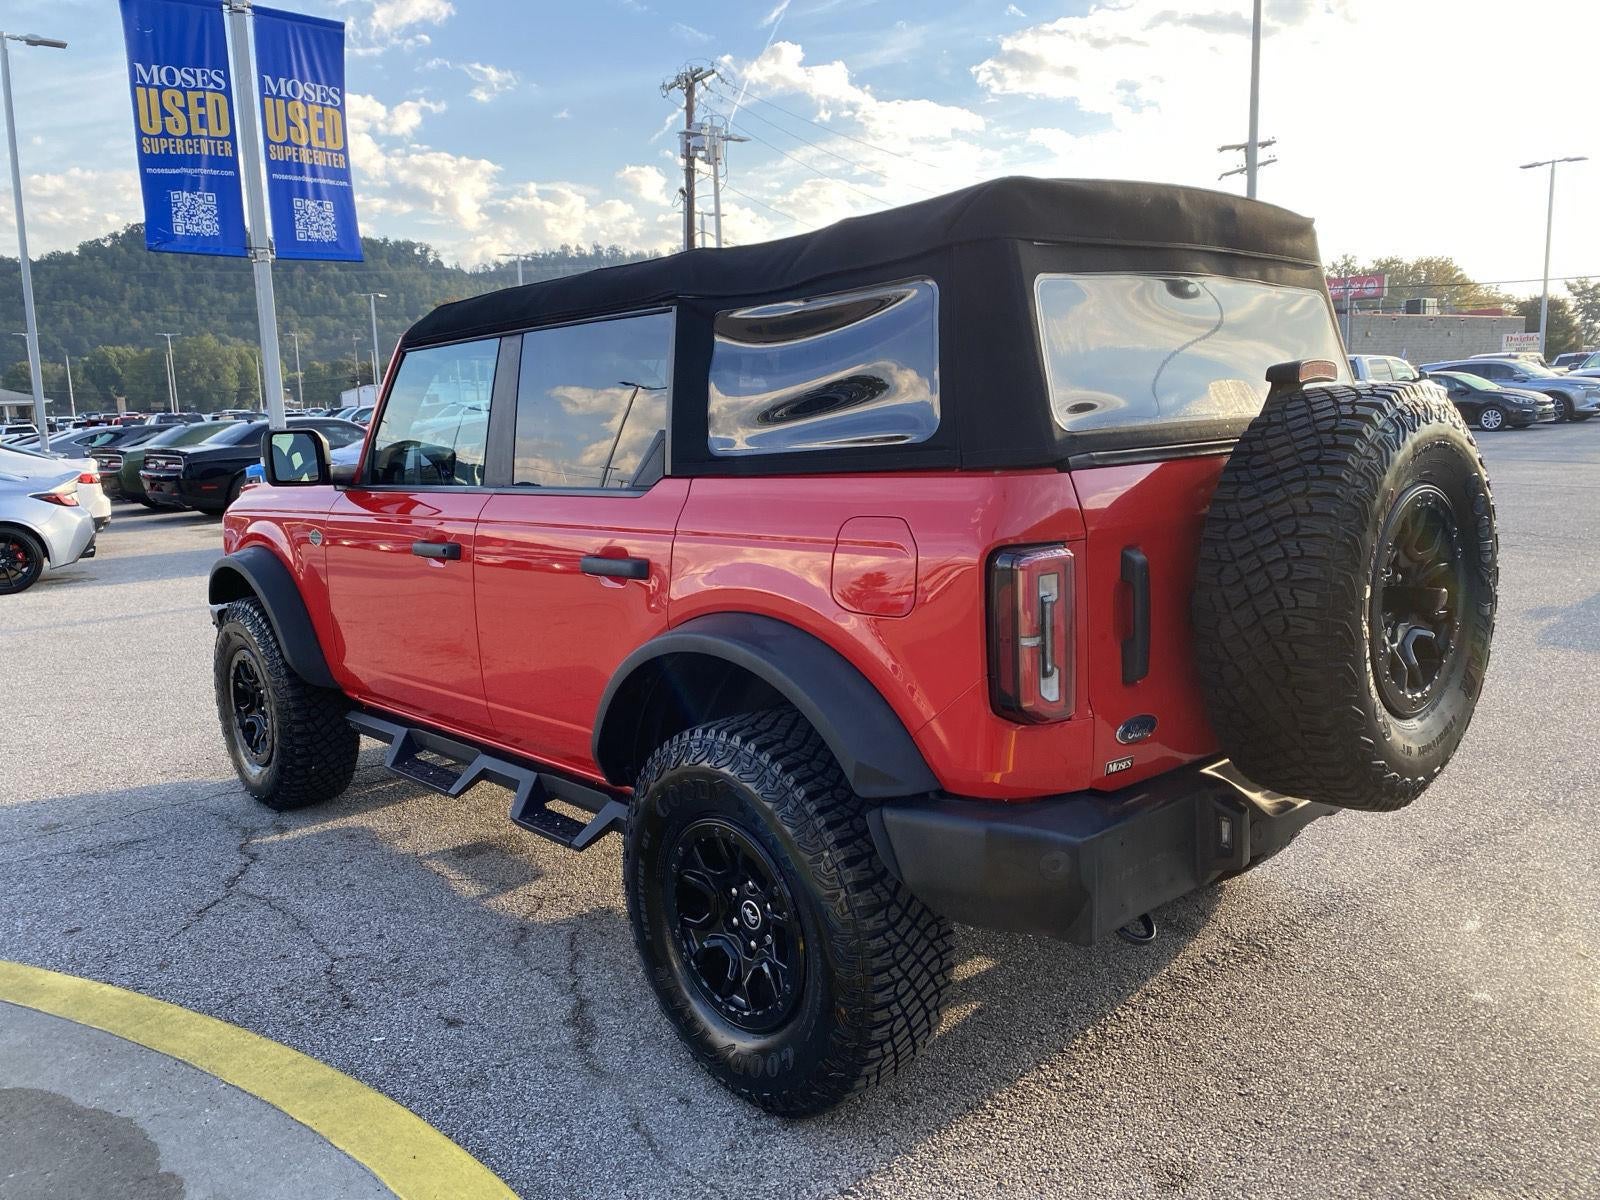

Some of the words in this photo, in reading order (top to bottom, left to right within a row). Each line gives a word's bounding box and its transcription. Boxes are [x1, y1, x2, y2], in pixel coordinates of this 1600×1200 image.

[133, 62, 226, 91] MOSES
[262, 74, 341, 107] MOSES
[136, 86, 231, 138] USED
[264, 97, 344, 151] USED
[142, 136, 233, 157] SUPERCENTER
[269, 144, 346, 169] SUPERCENTER
[146, 166, 235, 177] mosesusedsupercenter.com
[272, 173, 348, 186] mosesusedsupercenter.com
[1107, 760, 1132, 775] MOSES
